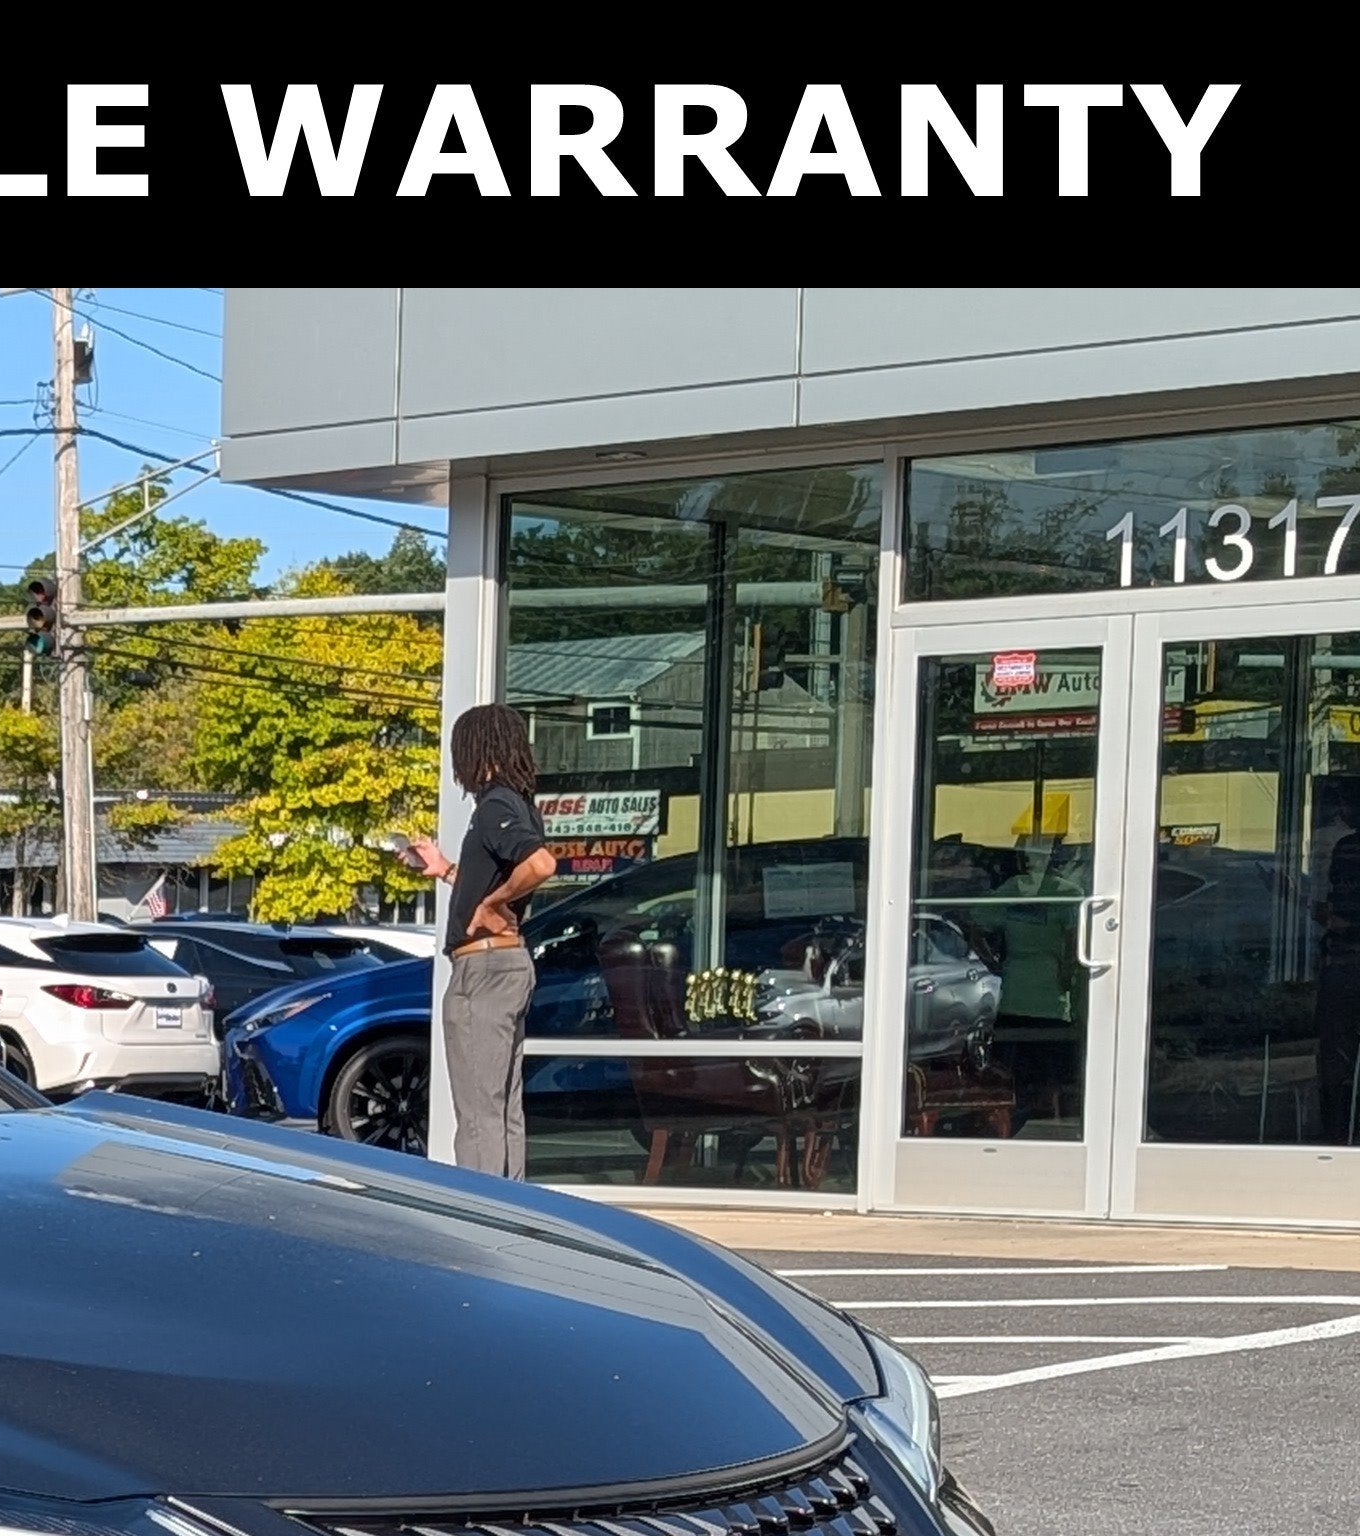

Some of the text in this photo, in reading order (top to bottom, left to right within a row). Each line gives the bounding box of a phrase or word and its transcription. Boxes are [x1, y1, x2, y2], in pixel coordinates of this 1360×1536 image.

[1106, 494, 1360, 588] 11317
[587, 797, 619, 815] AUTO
[621, 796, 657, 814] SALES
